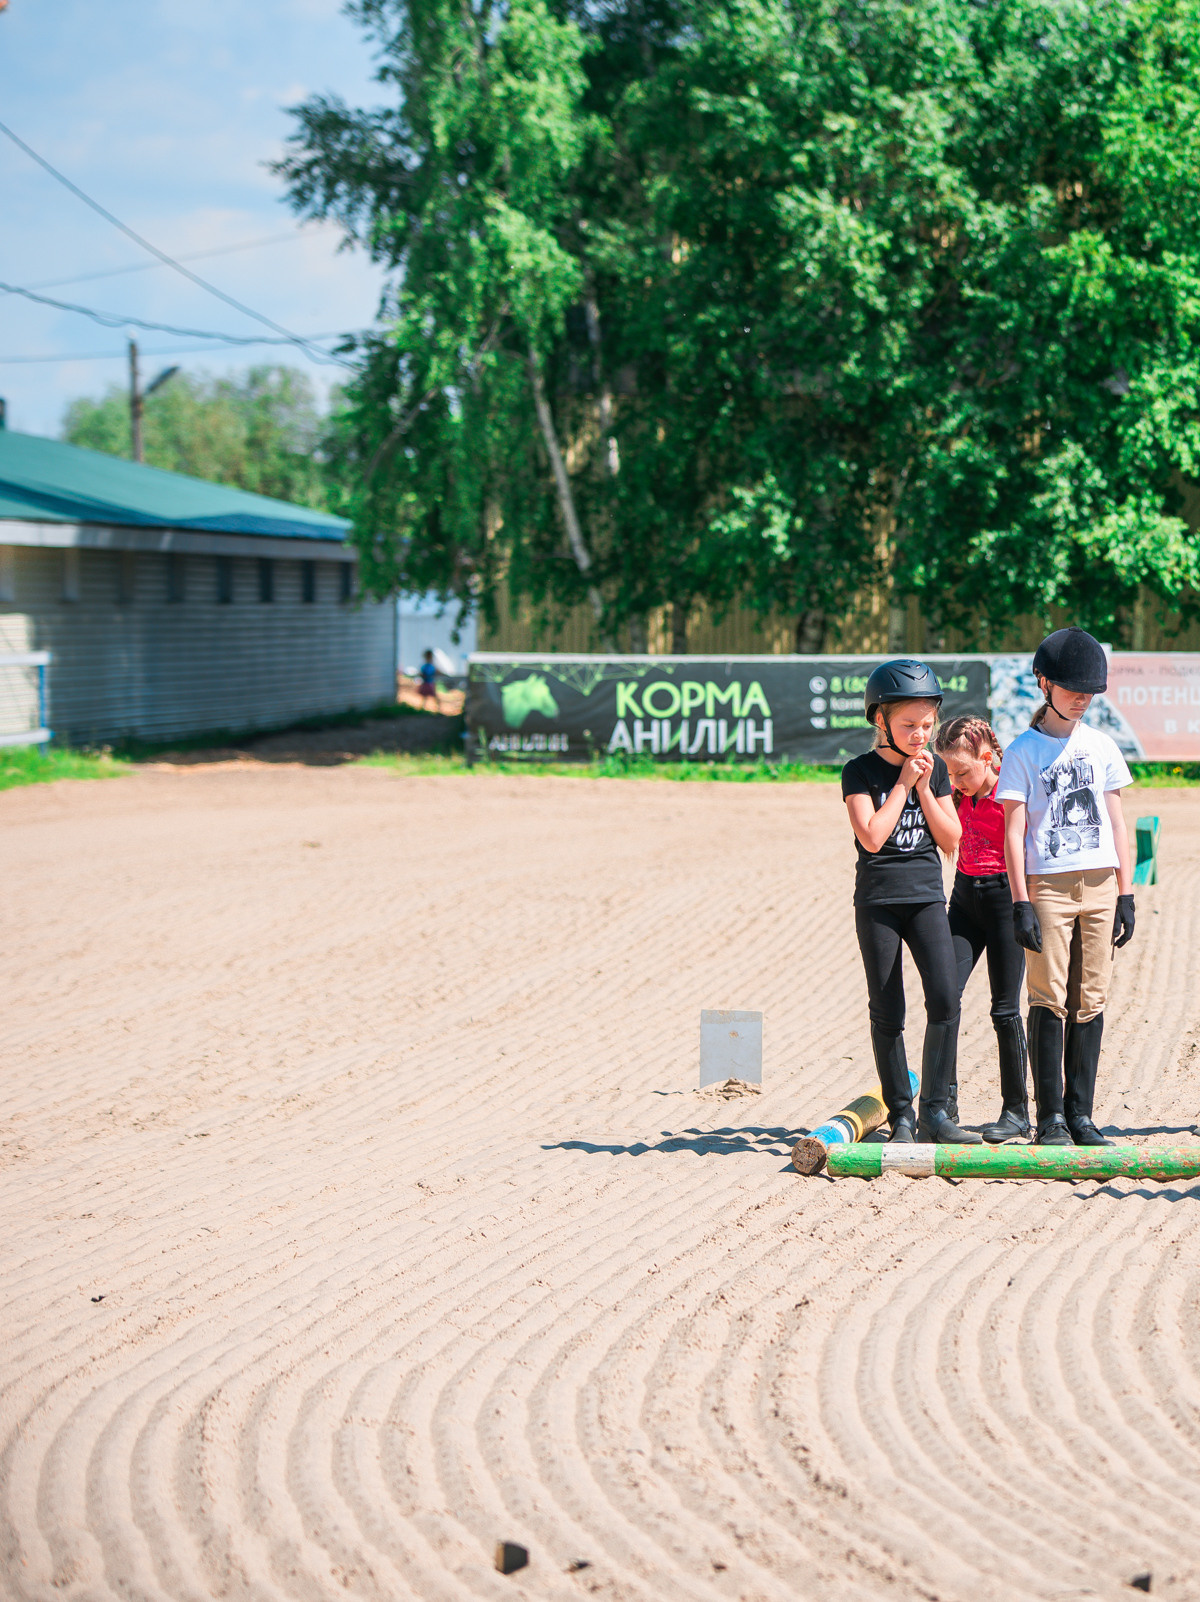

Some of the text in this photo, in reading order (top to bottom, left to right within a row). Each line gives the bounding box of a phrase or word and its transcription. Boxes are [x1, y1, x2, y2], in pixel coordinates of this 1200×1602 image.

[1108, 665, 1144, 677] ОРМА
[830, 676, 843, 694] 8
[616, 681, 772, 718] КОРМА
[1164, 718, 1178, 735] В
[608, 718, 774, 754] АНИЛИН
